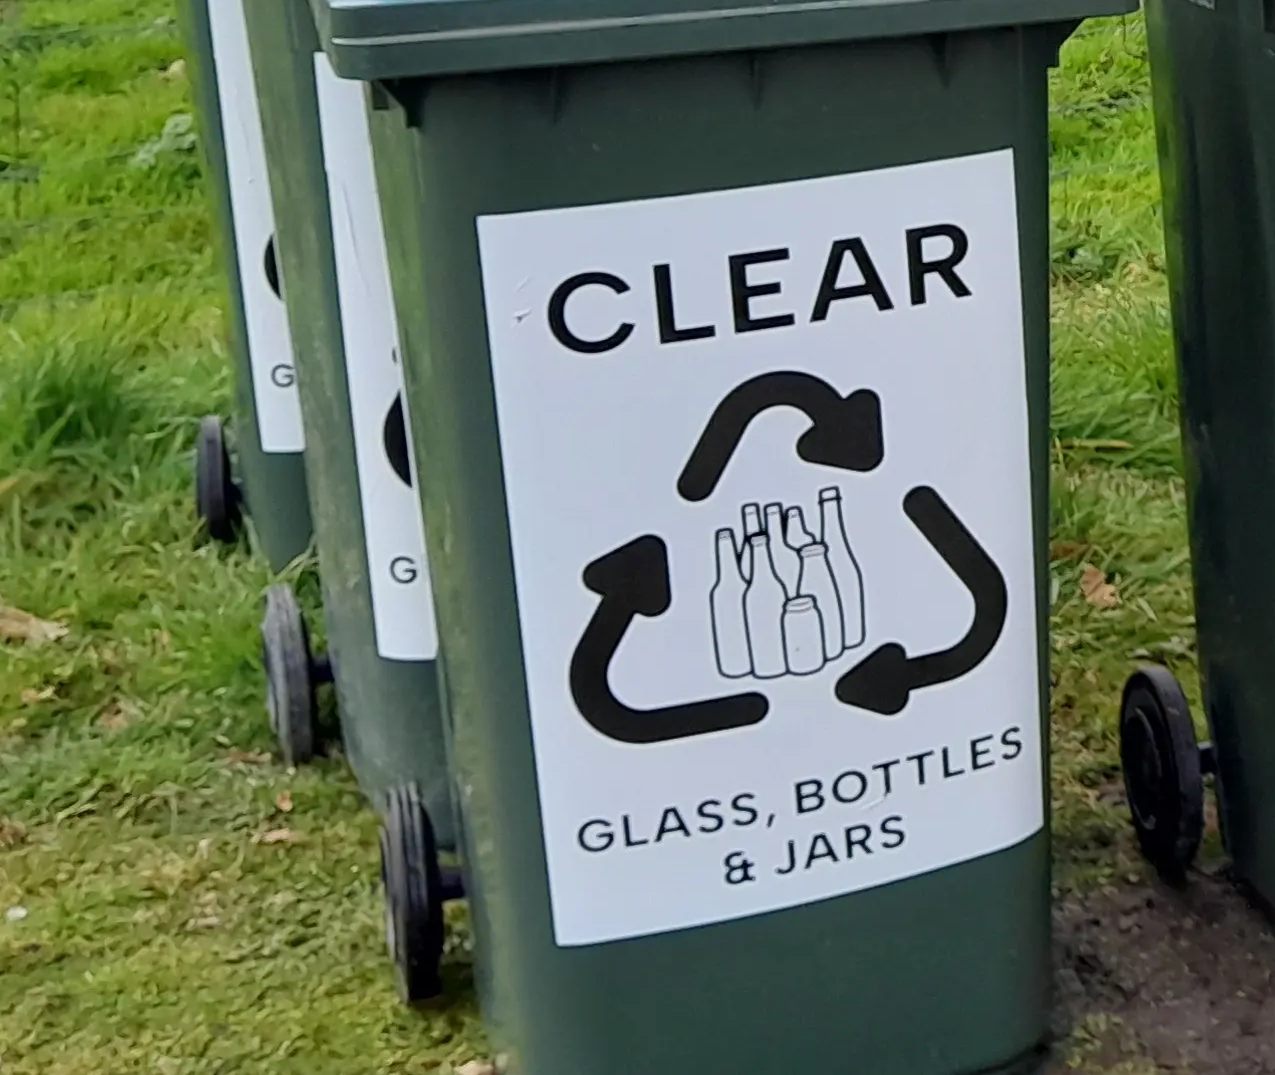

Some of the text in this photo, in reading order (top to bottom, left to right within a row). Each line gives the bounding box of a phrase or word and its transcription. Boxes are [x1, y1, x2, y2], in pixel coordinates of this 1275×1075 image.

[548, 224, 972, 353] CLEAR
[577, 727, 1024, 855] GLASS, BOTTLES
[724, 816, 906, 884] & JARS
